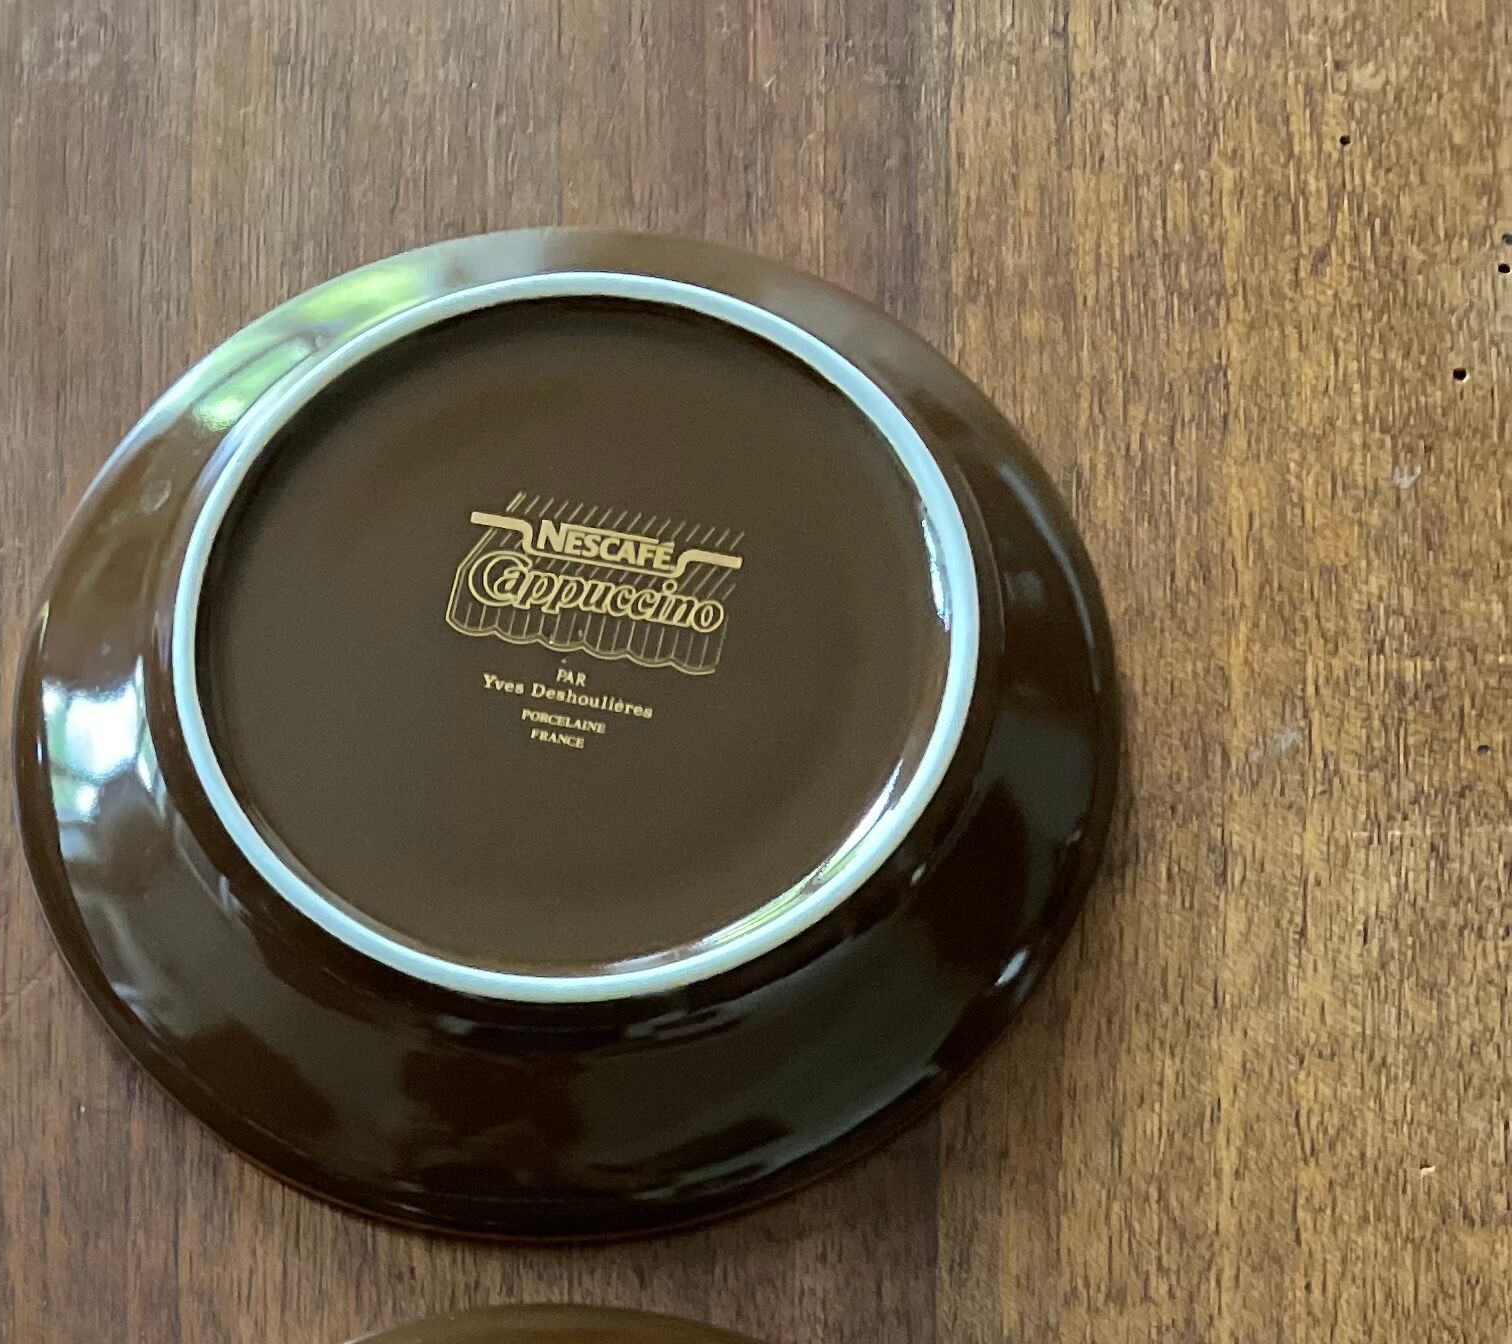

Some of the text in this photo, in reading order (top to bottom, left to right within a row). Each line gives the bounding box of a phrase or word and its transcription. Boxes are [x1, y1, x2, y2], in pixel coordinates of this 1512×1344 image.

[537, 519, 675, 571] NESCAFÉ
[469, 550, 724, 633] Cappuccino
[556, 668, 586, 687] PAR
[483, 673, 653, 719] Yves Deshoulières
[521, 708, 606, 734] PORCELAINE
[530, 729, 584, 749] FRANCE
